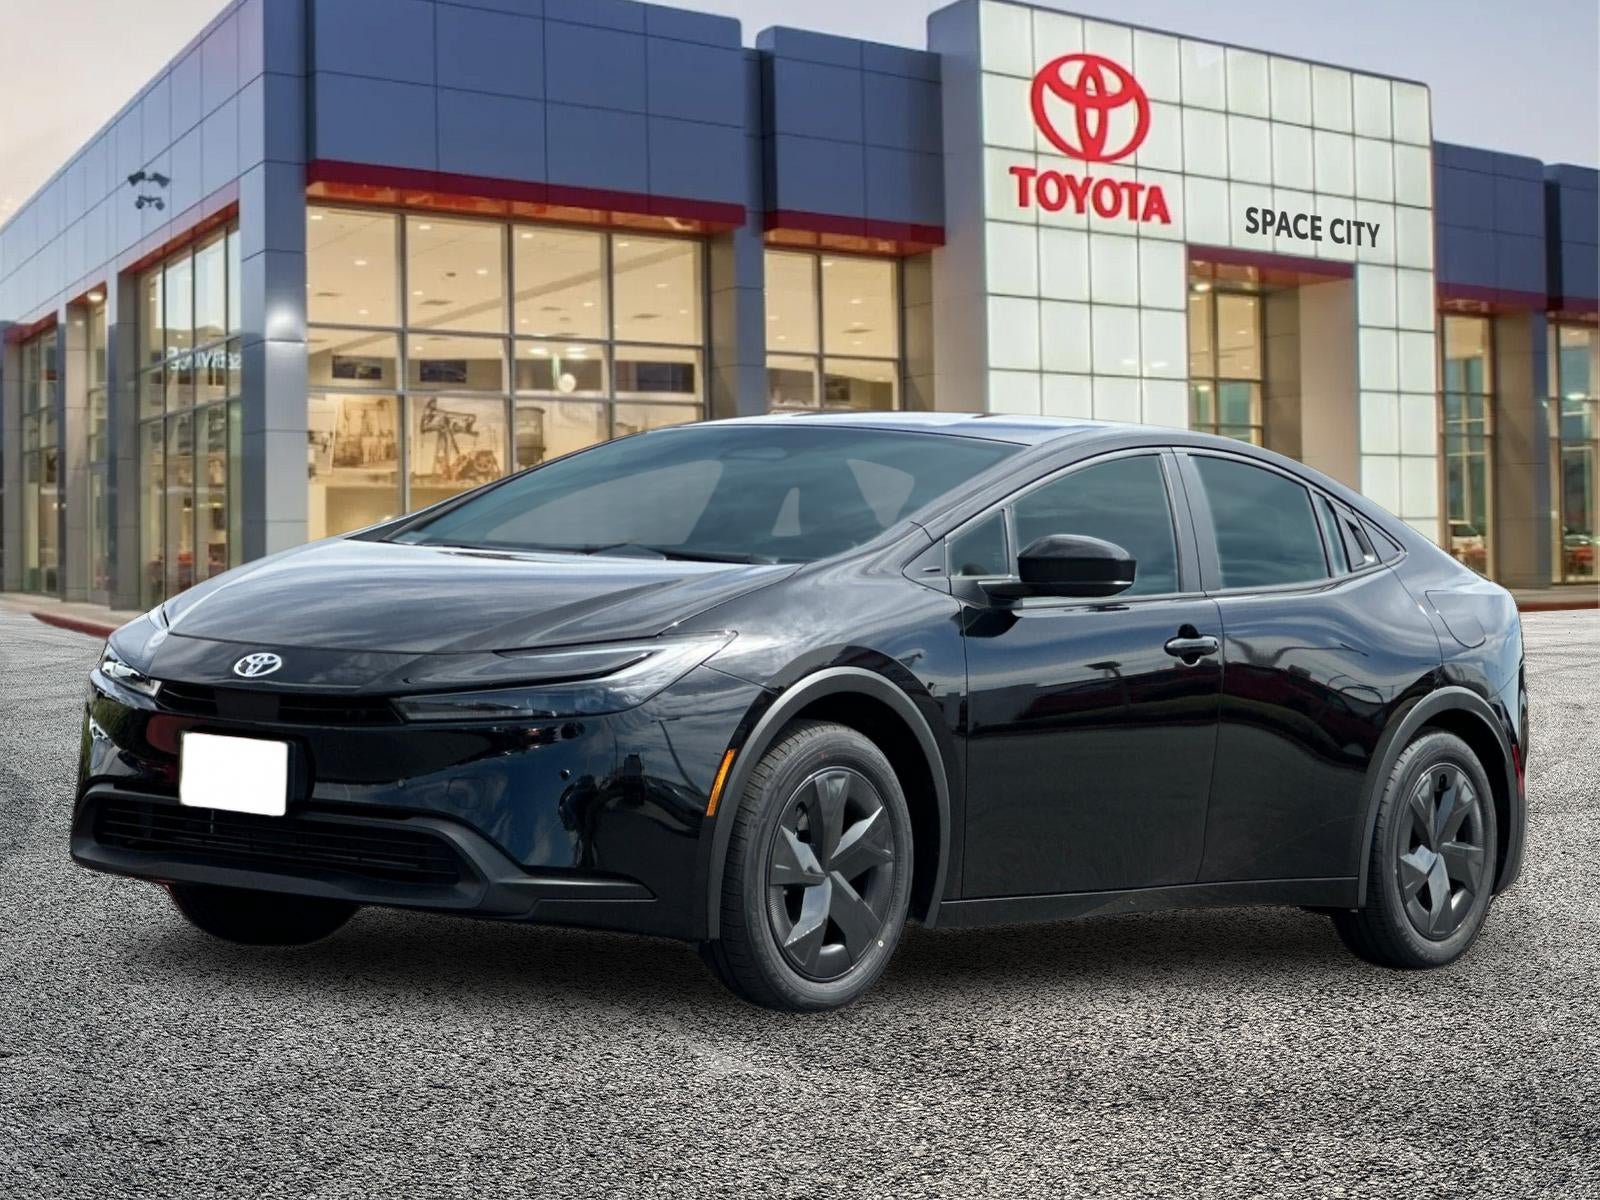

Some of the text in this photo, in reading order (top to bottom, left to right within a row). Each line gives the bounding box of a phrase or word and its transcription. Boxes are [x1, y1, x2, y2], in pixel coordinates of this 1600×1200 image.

[1009, 167, 1171, 225] TOYOTA
[1245, 206, 1380, 248] SPACE CITY
